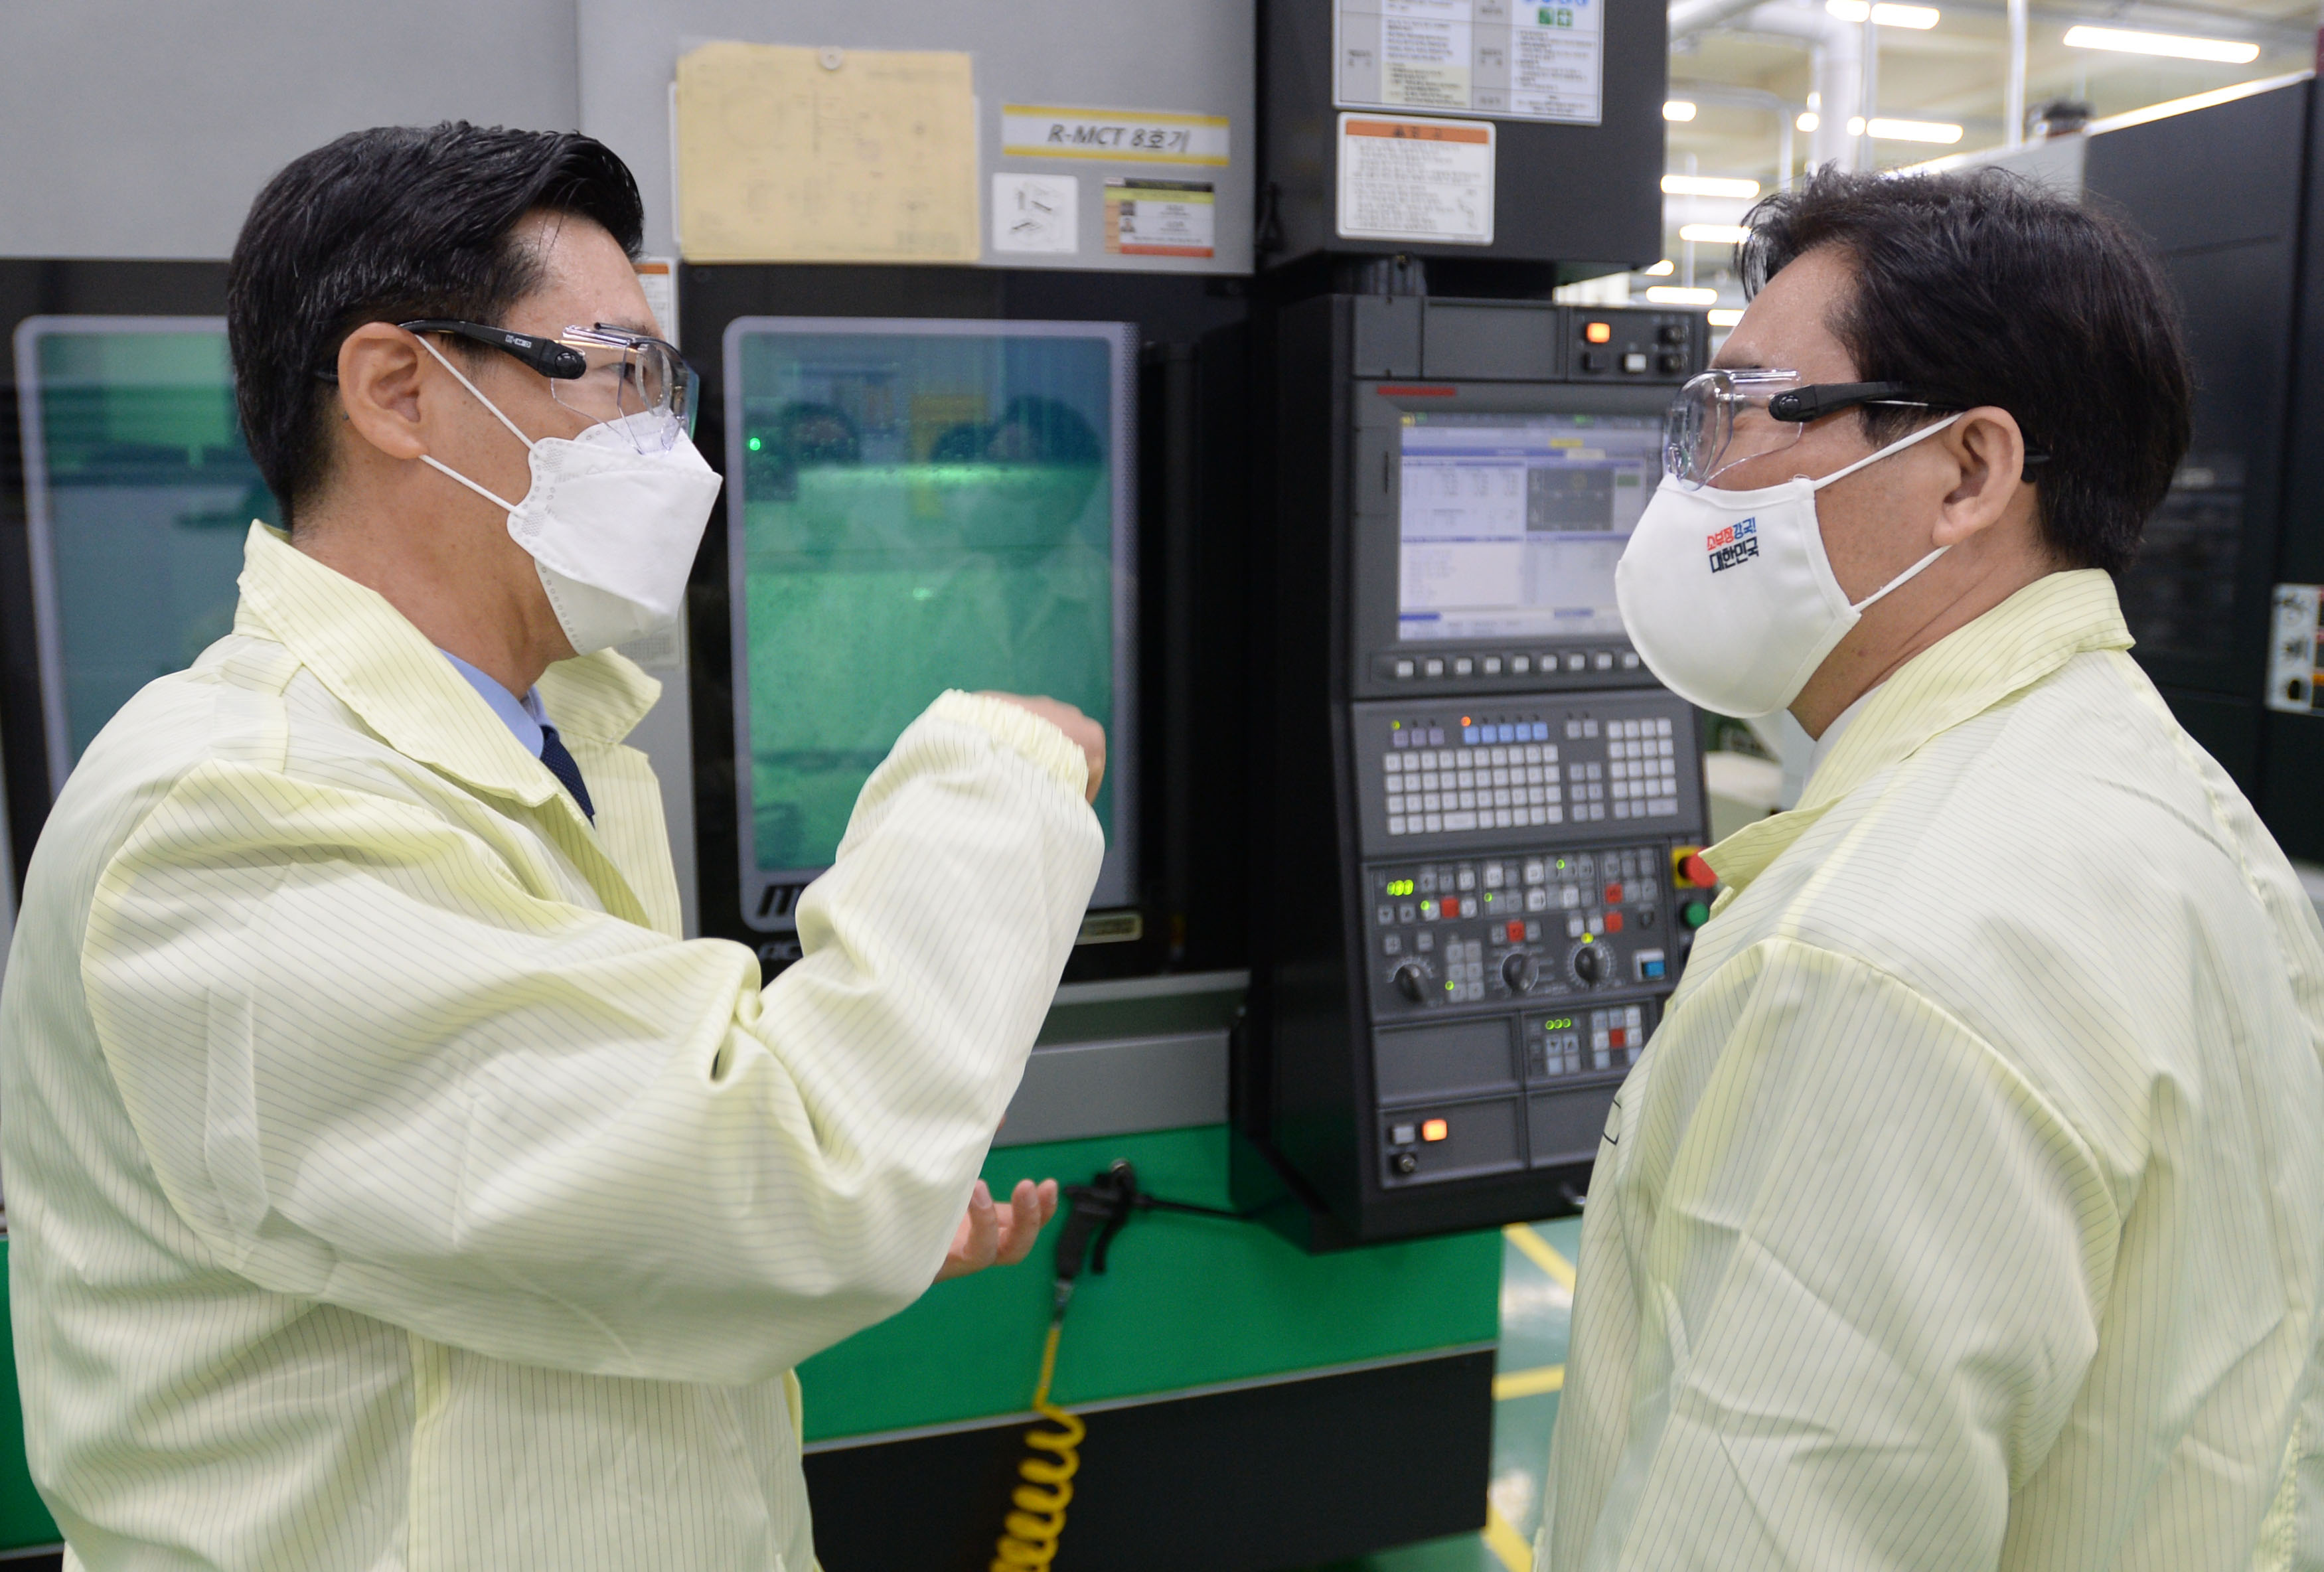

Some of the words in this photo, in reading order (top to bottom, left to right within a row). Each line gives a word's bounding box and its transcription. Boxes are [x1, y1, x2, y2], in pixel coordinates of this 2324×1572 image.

[1047, 123, 1126, 146] R-MCT
[1130, 128, 1190, 154] 8호기
[1709, 536, 1758, 573] 대한민국
